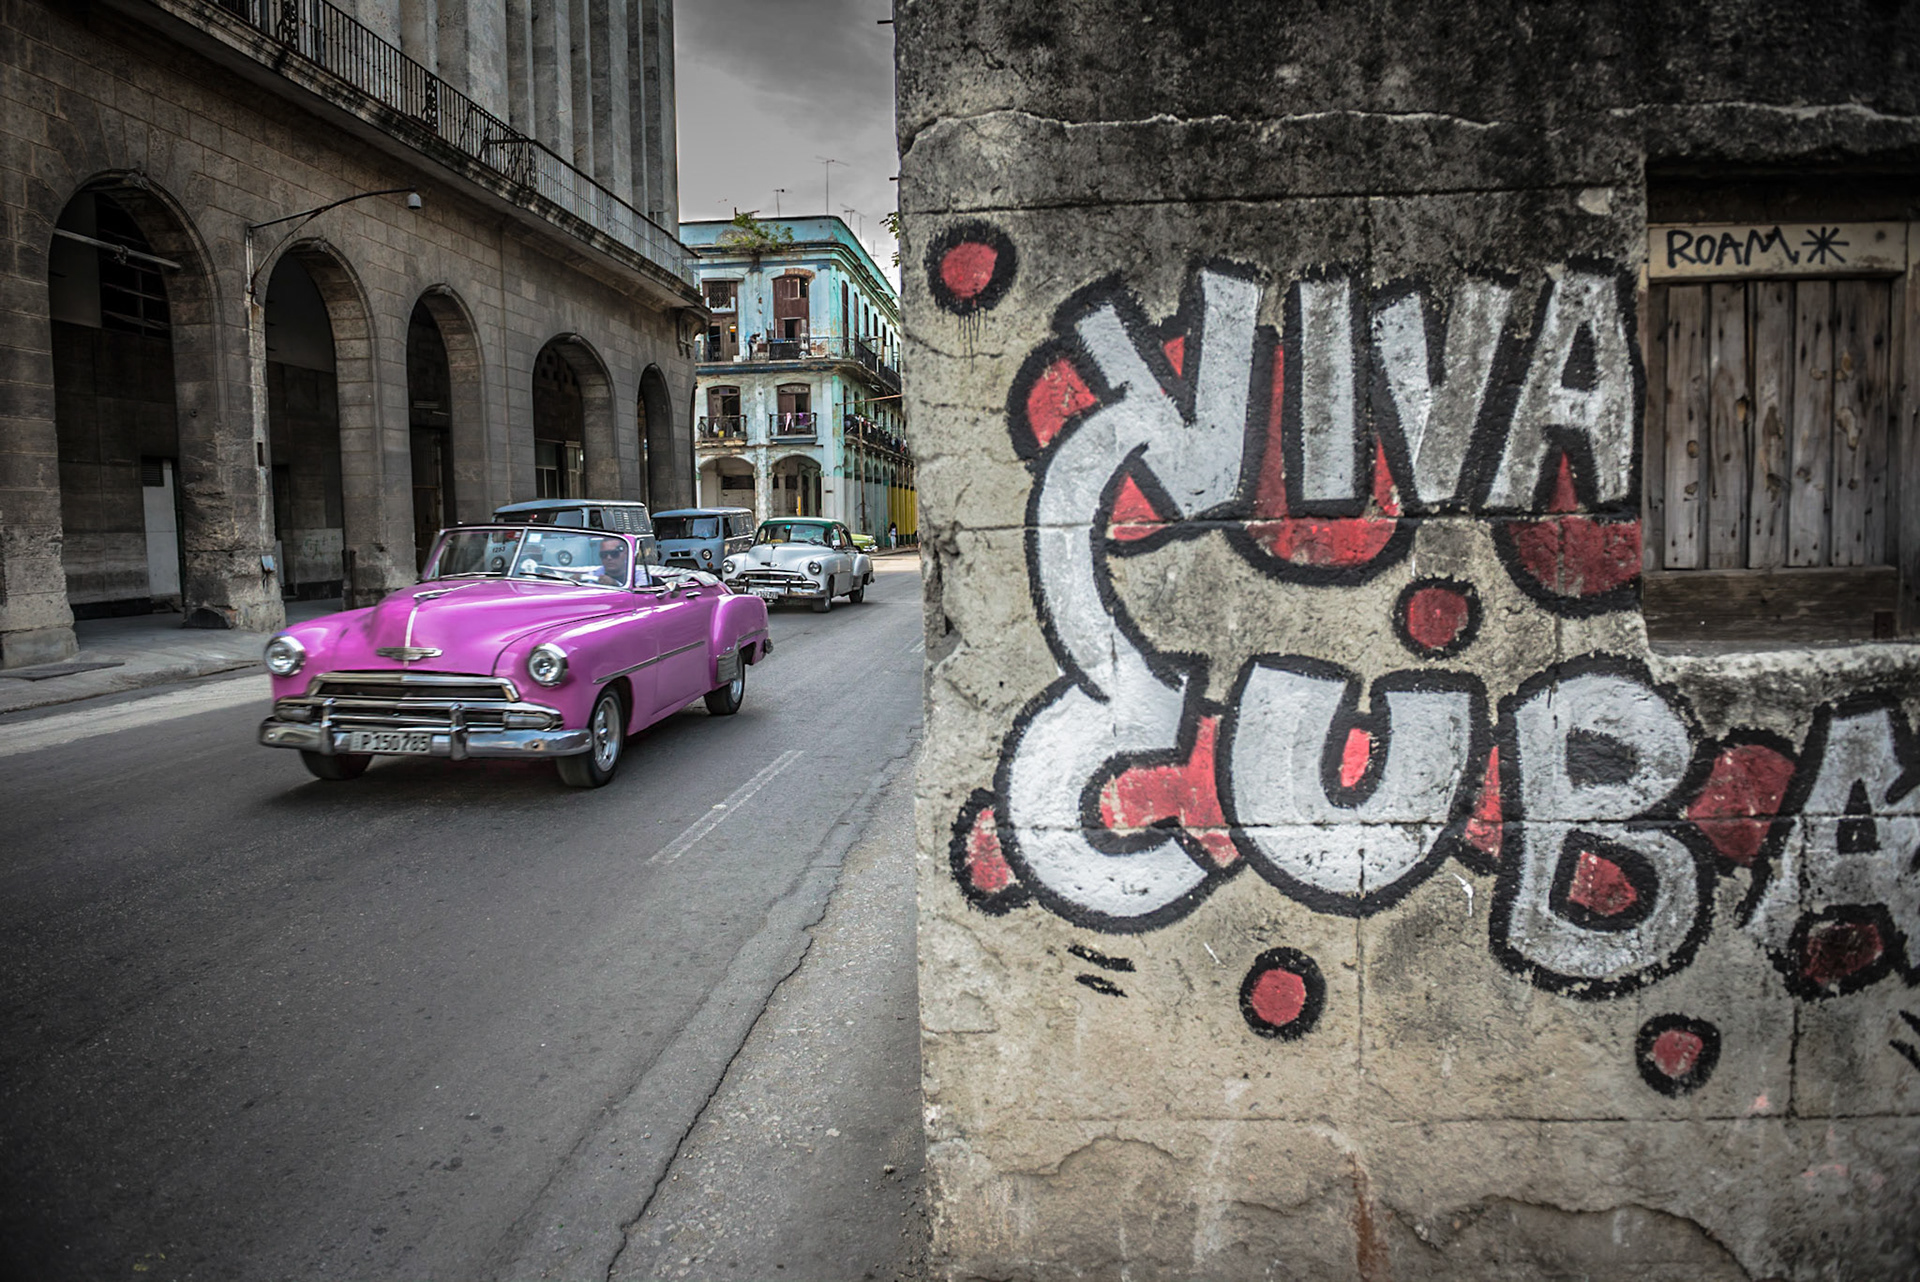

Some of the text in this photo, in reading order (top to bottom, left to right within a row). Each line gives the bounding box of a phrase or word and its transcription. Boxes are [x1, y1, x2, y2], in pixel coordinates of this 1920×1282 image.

[1666, 225, 1799, 268] ROAM
[1058, 260, 1644, 524] VIVA
[998, 655, 1920, 998] CUBA
